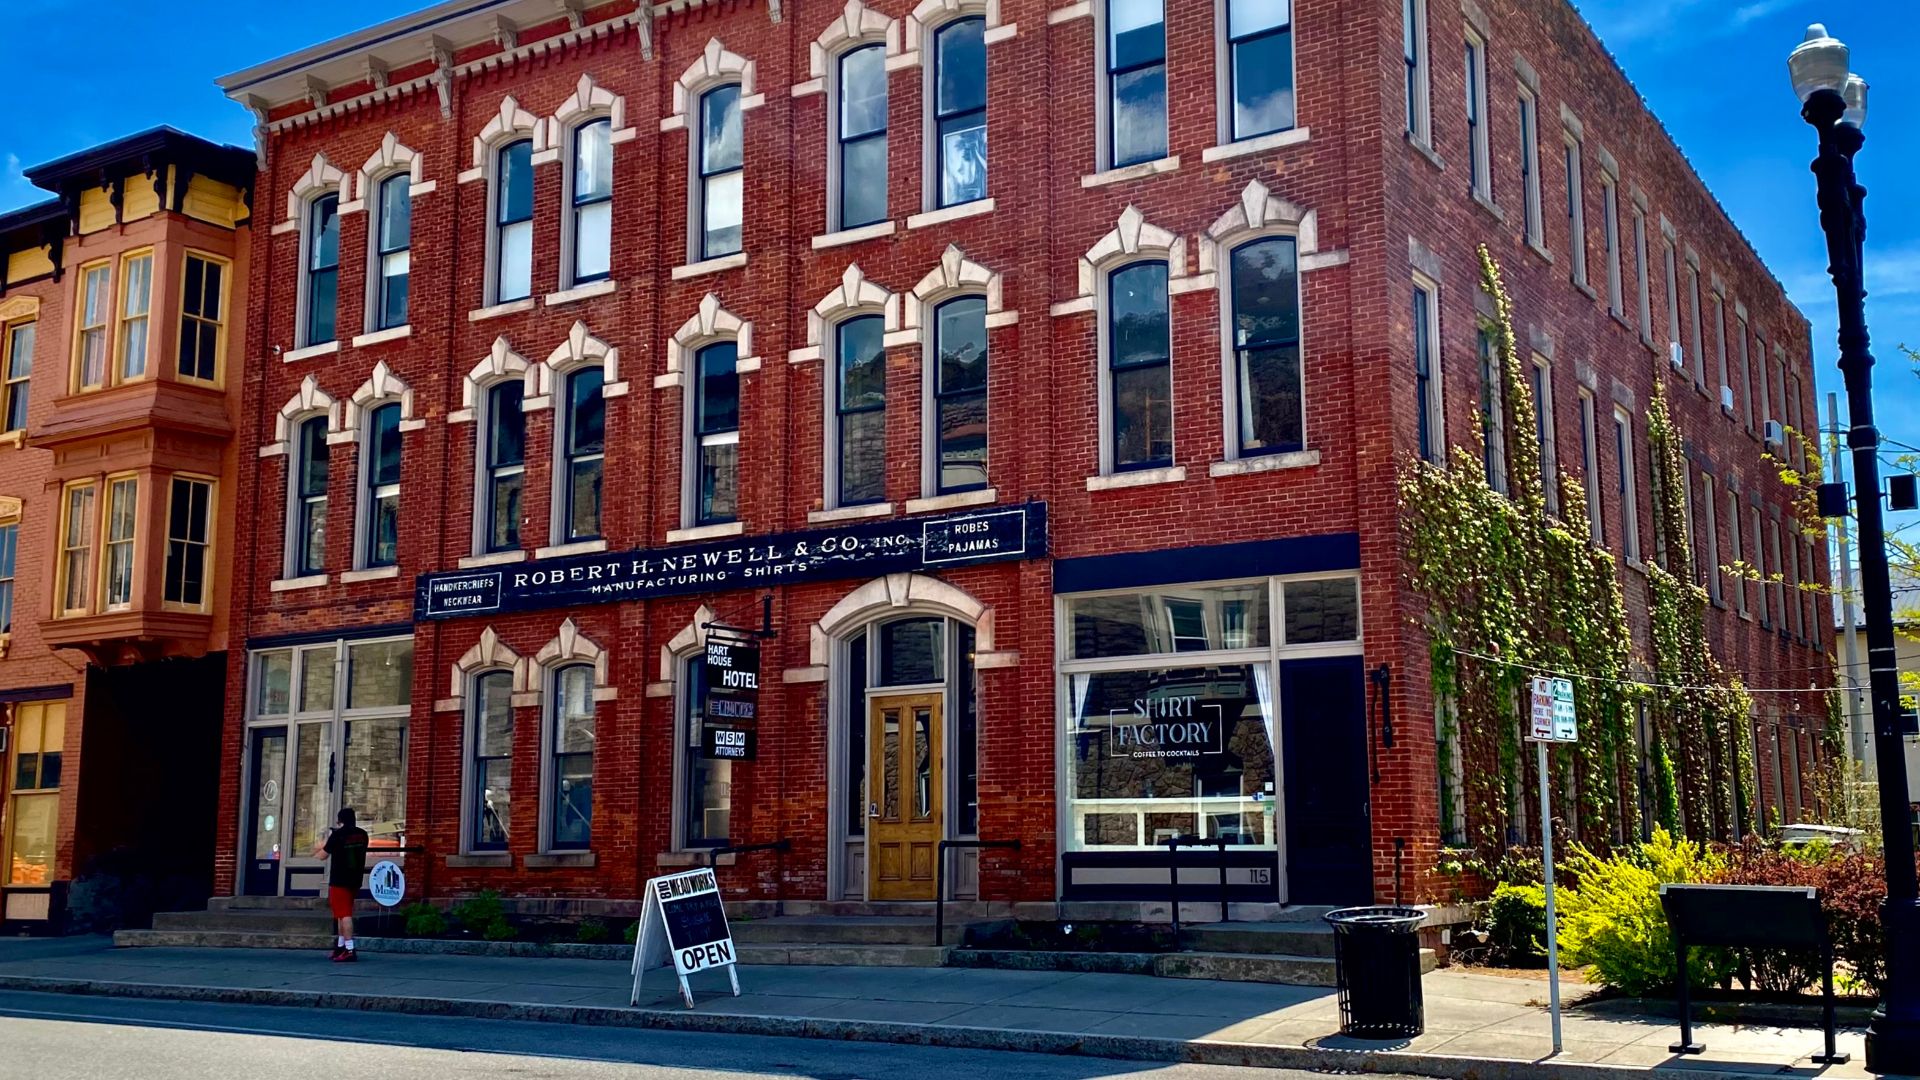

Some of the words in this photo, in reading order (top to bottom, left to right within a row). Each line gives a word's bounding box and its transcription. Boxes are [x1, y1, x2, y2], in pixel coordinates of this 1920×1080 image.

[954, 521, 989, 534] ROBES
[948, 538, 999, 553] PAJAMAS
[513, 562, 621, 588] ROBERT
[631, 560, 654, 575] H.
[662, 545, 782, 571] NEWELL
[794, 541, 809, 556] &
[820, 536, 866, 553] CO.
[591, 571, 727, 594] MANUFACTURING
[743, 562, 808, 577] SHIRTS
[443, 595, 482, 607] NECKWEAR
[708, 644, 729, 656] HART
[707, 655, 732, 667] HOUSE
[722, 670, 758, 688] HOTEL
[1538, 680, 1547, 694] NO
[1133, 695, 1197, 718] SHIRT
[715, 730, 745, 746] WSM
[1119, 721, 1213, 746] FACTORY
[715, 746, 745, 757] ATTORNEYS
[1133, 750, 1157, 758] COFFEE
[1157, 750, 1166, 758] TO
[1166, 749, 1200, 757] COCKTAILS
[1249, 869, 1269, 884] 115
[668, 871, 716, 898] MEADWORKS
[681, 940, 732, 970] OPEN
